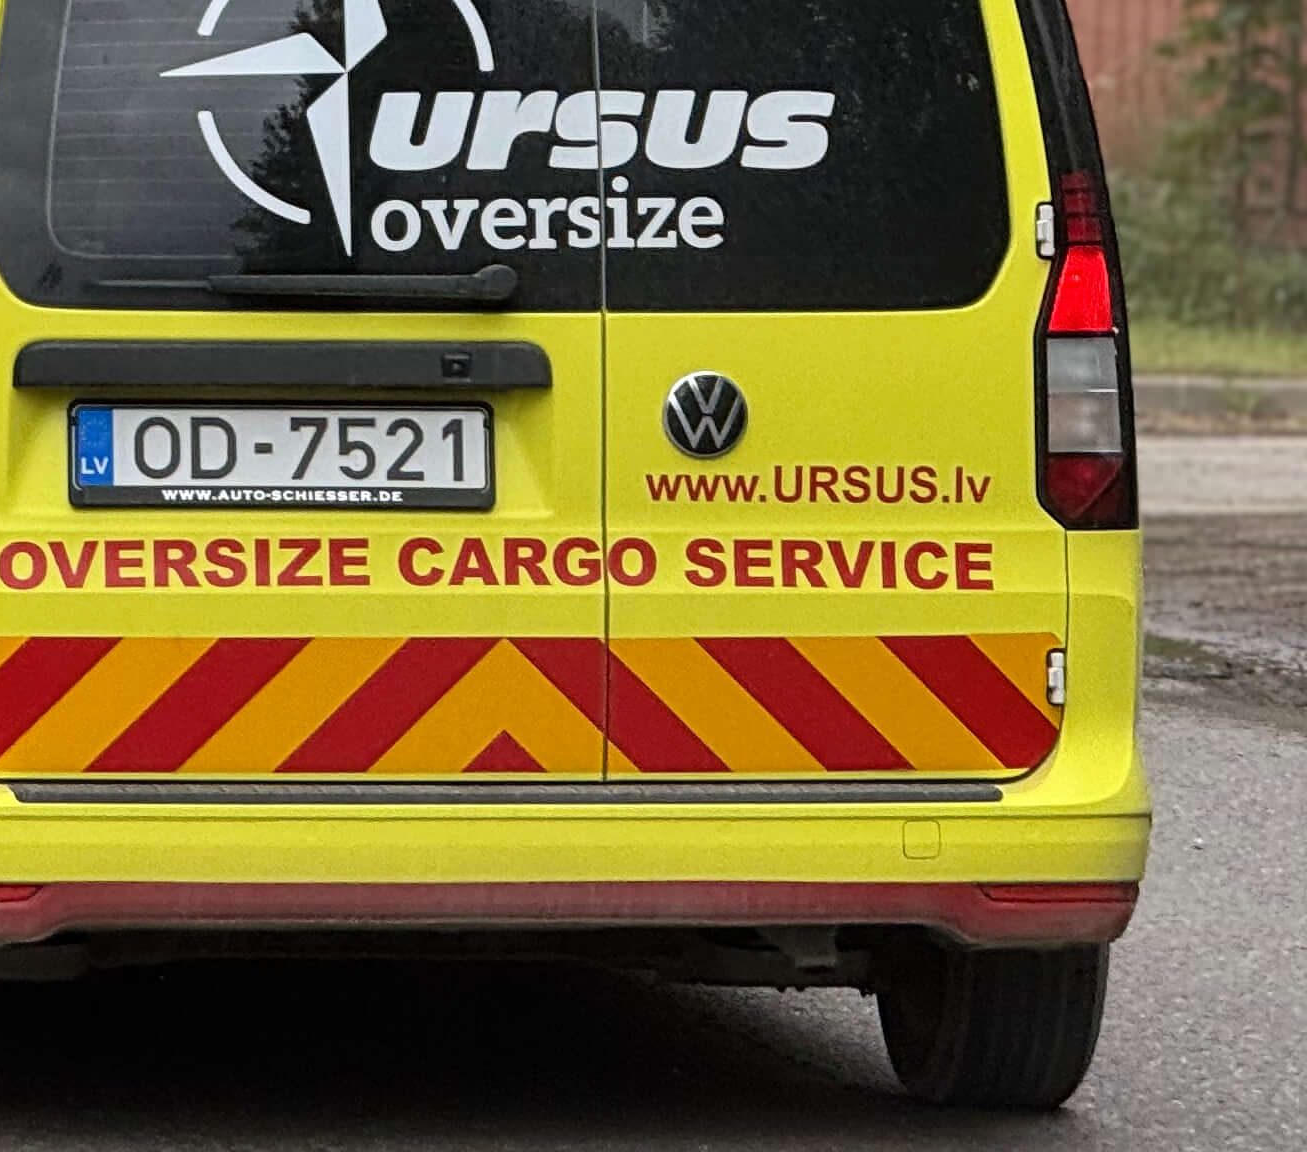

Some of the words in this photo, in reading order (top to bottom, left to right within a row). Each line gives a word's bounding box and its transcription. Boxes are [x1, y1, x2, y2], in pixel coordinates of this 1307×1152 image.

[371, 175, 725, 251] oversize
[81, 458, 109, 475] LV
[134, 416, 464, 482] OD-7521
[162, 489, 403, 502] WWW.AUTO-SCHIESSER.DE
[646, 465, 991, 503] www.URSUS.lv
[398, 537, 658, 587] CARGO
[685, 539, 994, 590] SERVICE
